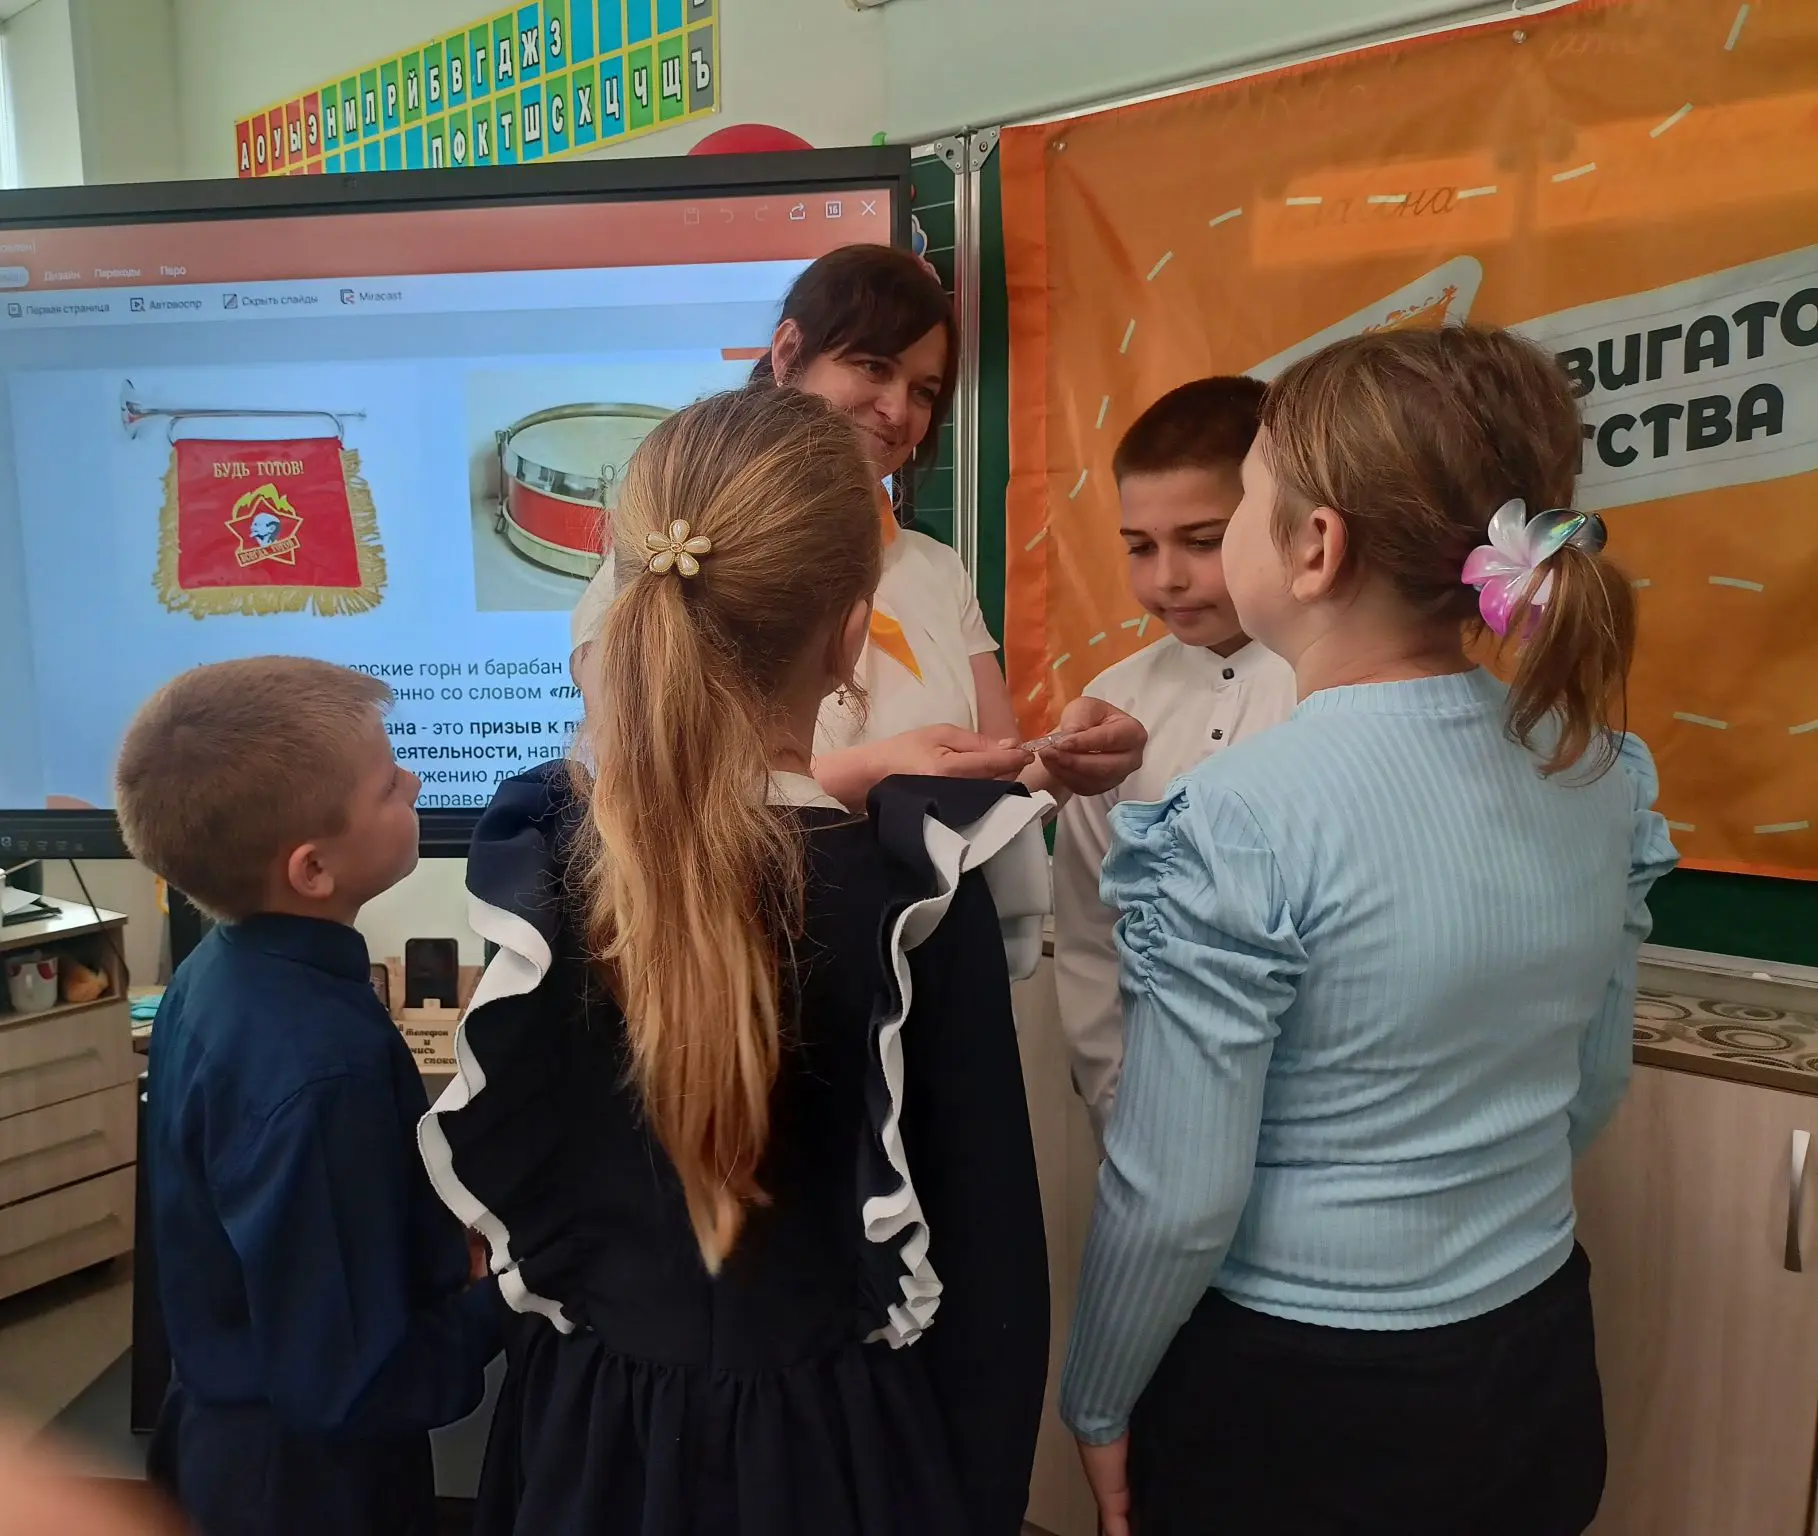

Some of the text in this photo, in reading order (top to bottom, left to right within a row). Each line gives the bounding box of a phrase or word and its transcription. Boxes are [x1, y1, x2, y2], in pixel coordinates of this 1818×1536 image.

[241, 17, 562, 171] А О У Ы Э Н М Л Р Й Б В Г Д Ж З
[432, 49, 711, 168] П Ф К Т Ш С Х Ц Ч Щ Ъ
[160, 265, 187, 278] Перо
[242, 294, 318, 307] Скрыть слайды
[359, 291, 402, 302] Miracast
[26, 303, 110, 316] Первая страница
[149, 299, 202, 311] Автовоспр
[1555, 287, 1818, 399] ВИГАТО
[213, 460, 304, 479] БУДЬ ГОТОВ!
[346, 658, 562, 680] ерские горн и барабан
[392, 685, 582, 700] енно со словом «пи
[385, 722, 416, 735] ана
[433, 722, 464, 735] это
[470, 721, 542, 739] призыв
[548, 721, 559, 734] к
[393, 745, 521, 761] еятельности,
